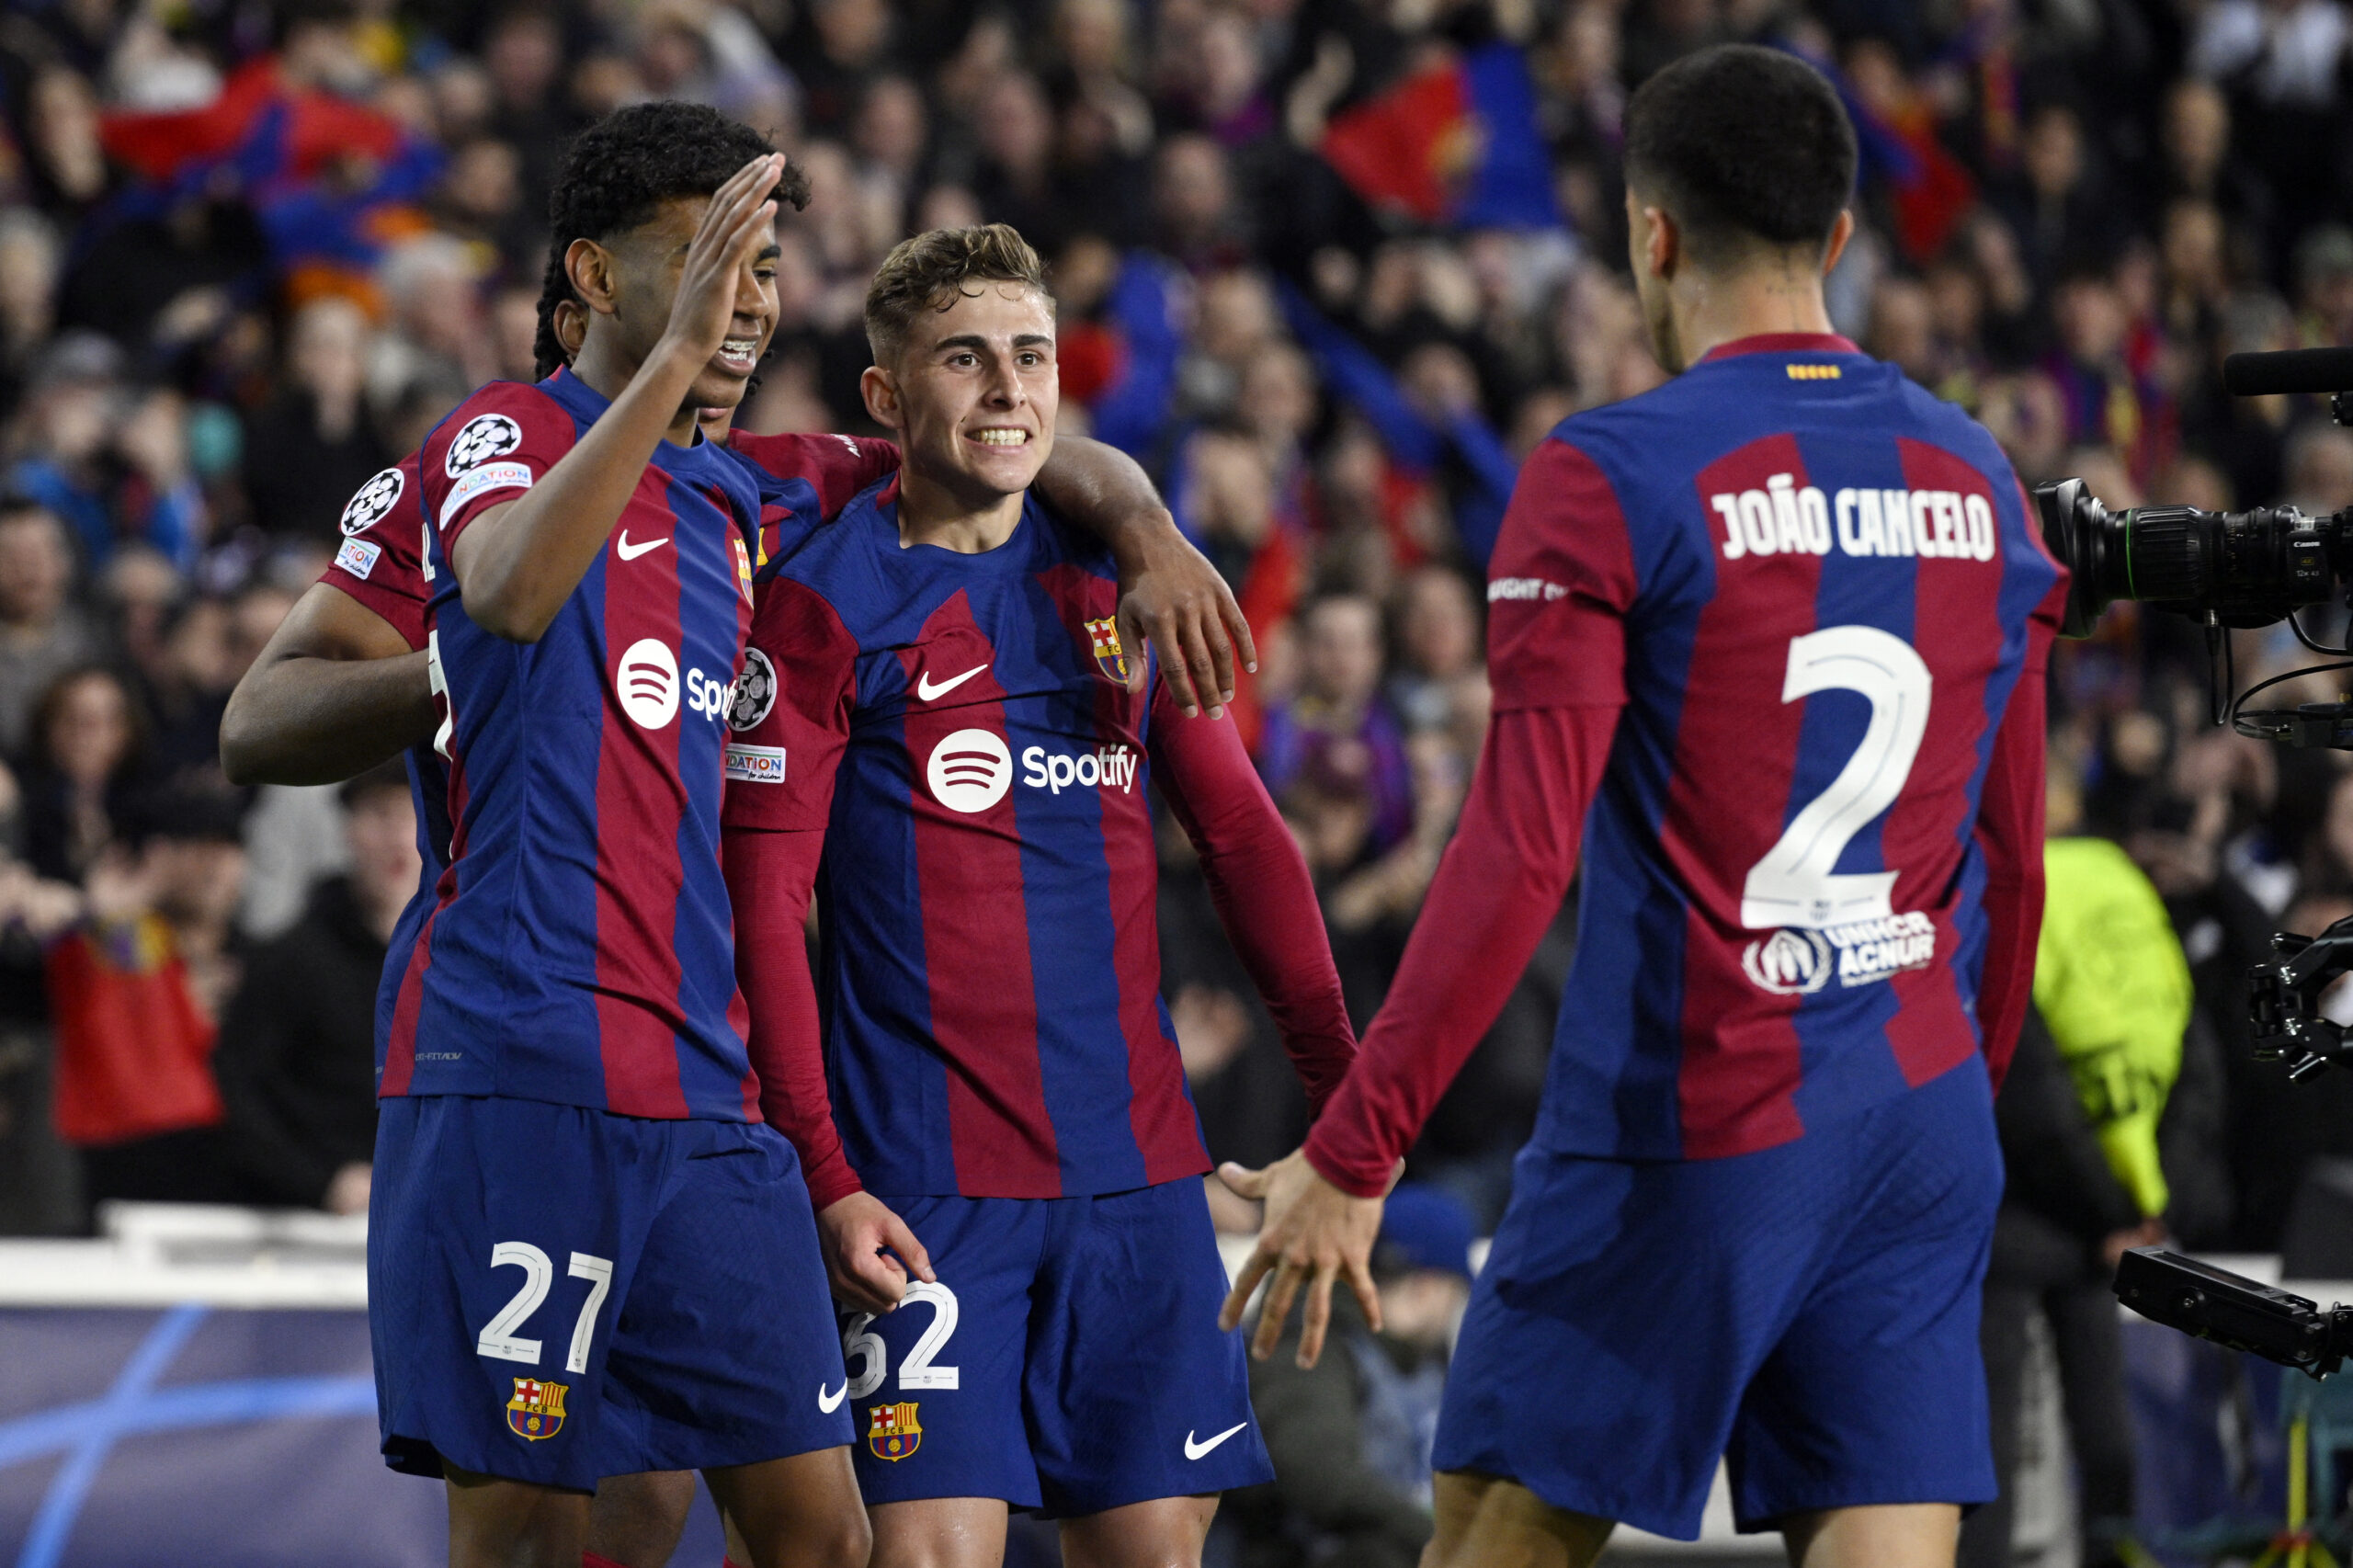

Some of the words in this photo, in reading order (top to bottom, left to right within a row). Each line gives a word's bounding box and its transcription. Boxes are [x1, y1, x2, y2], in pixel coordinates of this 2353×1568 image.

[1711, 472, 1832, 561] JOÃO
[1836, 487, 1996, 562] CANCELO
[1021, 744, 1138, 795] Spotify
[1740, 624, 1933, 930] 2
[1839, 933, 1936, 978] ACNUR
[476, 1241, 614, 1375] 27
